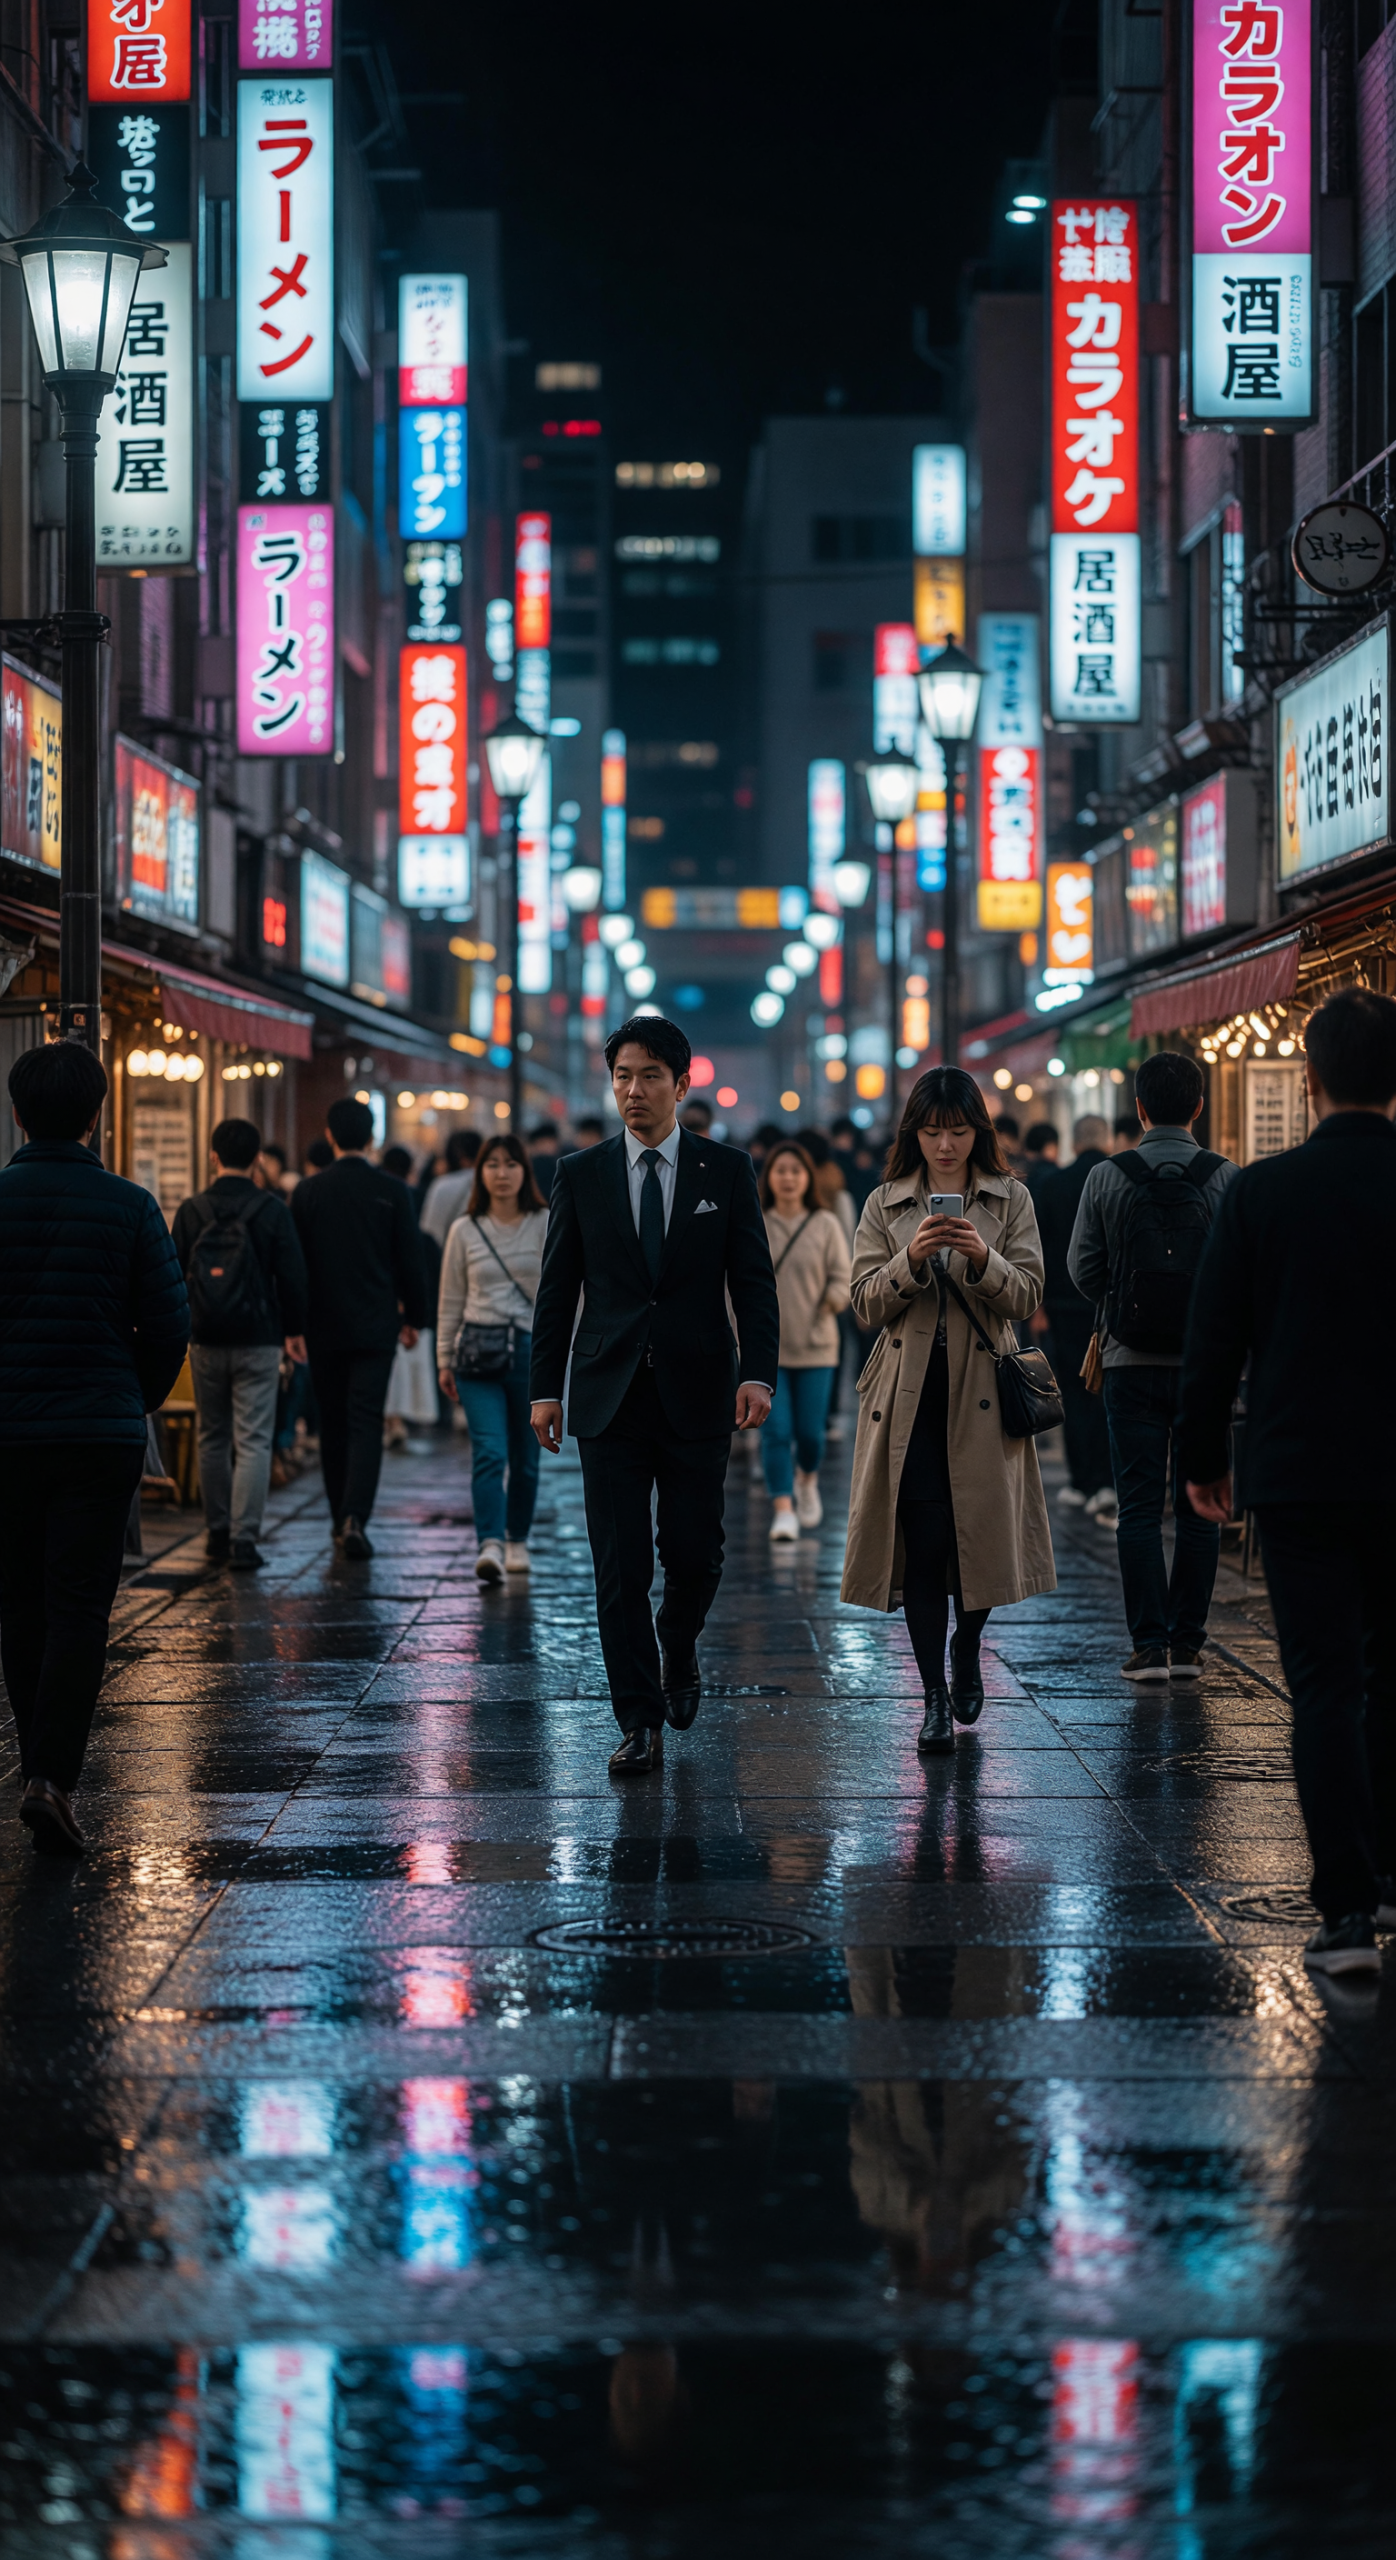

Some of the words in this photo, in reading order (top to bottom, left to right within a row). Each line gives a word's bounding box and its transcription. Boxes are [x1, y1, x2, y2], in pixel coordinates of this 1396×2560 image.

[258, 119, 314, 377] ラーメン
[1221, 275, 1283, 400] 酒屋
[111, 301, 169, 494] 居酒屋
[1064, 293, 1125, 526] カラオケ
[255, 535, 304, 736] ラーメン
[1073, 550, 1118, 697] 居酒屋
